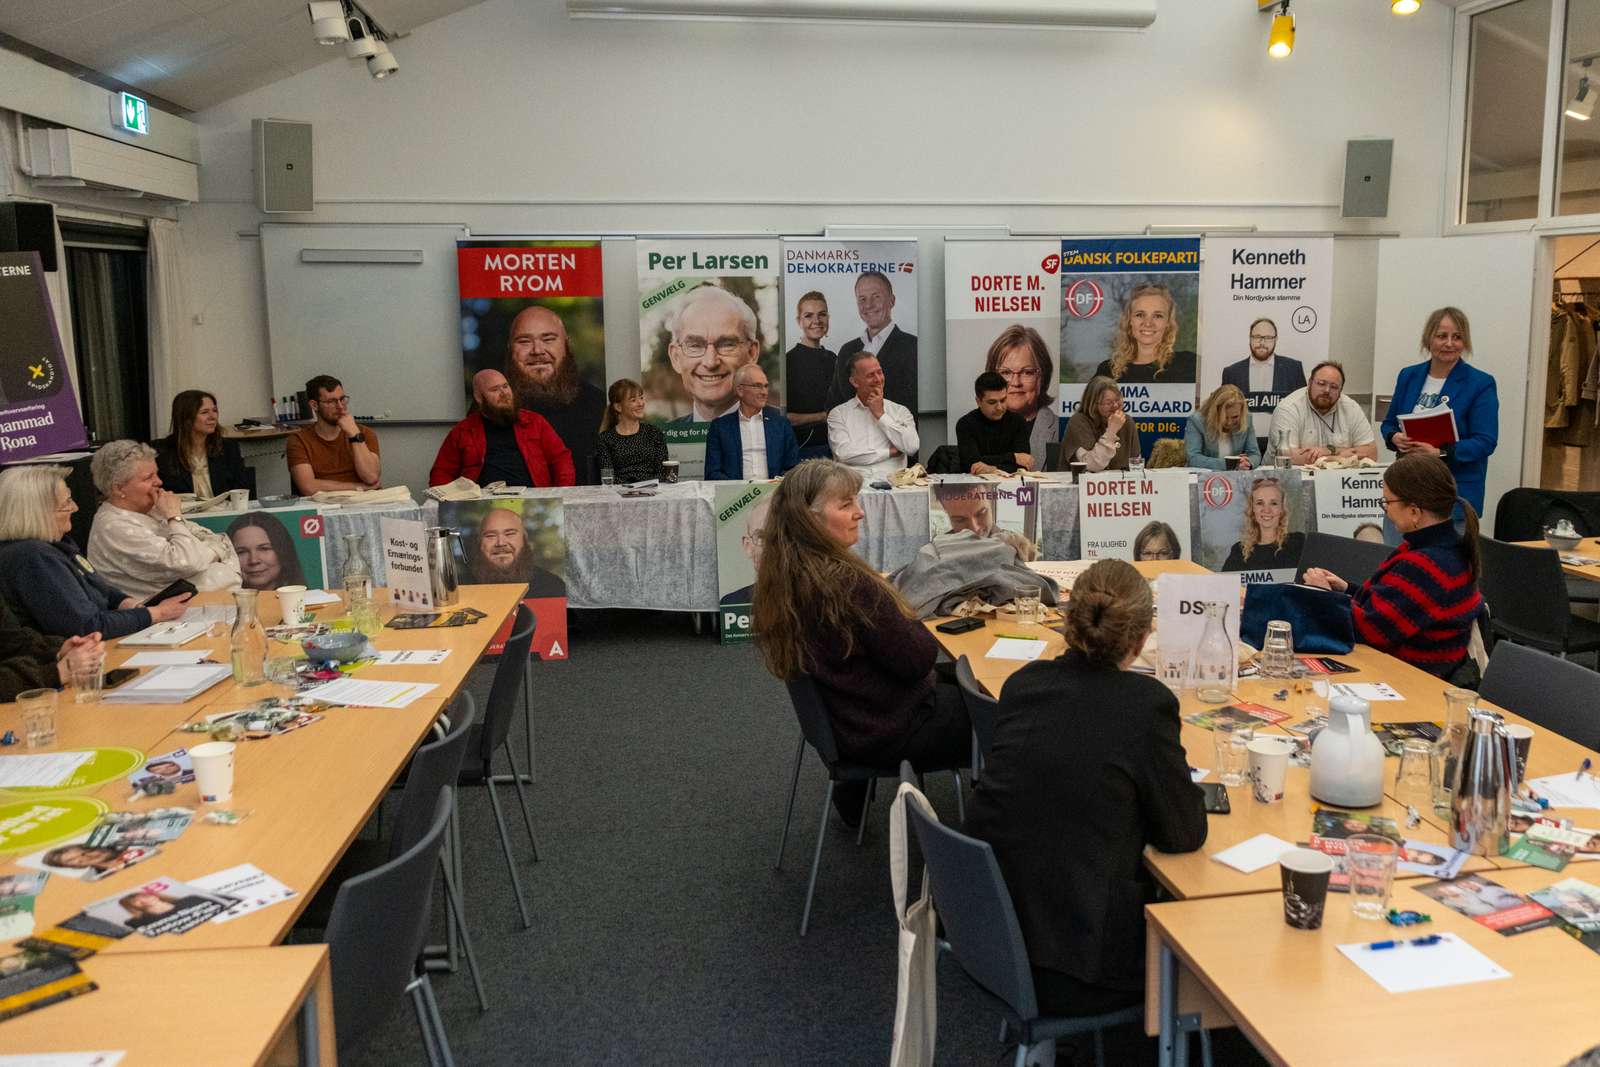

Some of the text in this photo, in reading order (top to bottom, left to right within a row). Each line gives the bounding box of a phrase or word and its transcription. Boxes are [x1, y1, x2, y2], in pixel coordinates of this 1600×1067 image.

[484, 253, 576, 271] MORTEN
[648, 251, 768, 270] Per Larsen
[786, 249, 859, 261] DANMARKS
[1064, 251, 1198, 265] DANSK FOLKEPARTI
[1232, 248, 1306, 265] Kenneth
[0, 265, 32, 277] ERNE
[787, 262, 896, 274] DEMOKRATERNE
[1044, 258, 1058, 270] SF
[500, 274, 564, 292] RYOM
[971, 275, 1045, 291] DORTE M.
[1231, 273, 1306, 289] Hammer
[641, 280, 686, 309] GENVÆLG
[1076, 293, 1093, 304] DF
[975, 296, 1041, 312] NIELSEN
[1298, 314, 1311, 325] LA
[1260, 395, 1281, 407] Alli
[1158, 422, 1180, 433] DIG:
[1, 435, 37, 450] Rona
[1086, 480, 1158, 496] DORTE M.
[1341, 476, 1384, 489] Kenne
[719, 487, 761, 522] GENVÆLG
[1087, 501, 1152, 517] NIELSEN
[390, 537, 418, 551] Kost- og
[1100, 540, 1127, 548] ULIGHED
[391, 560, 423, 574] forbundet
[1240, 571, 1274, 584] EMMA
[1180, 600, 1205, 615] DS
[724, 612, 750, 630] Pe
[549, 640, 564, 657] A
